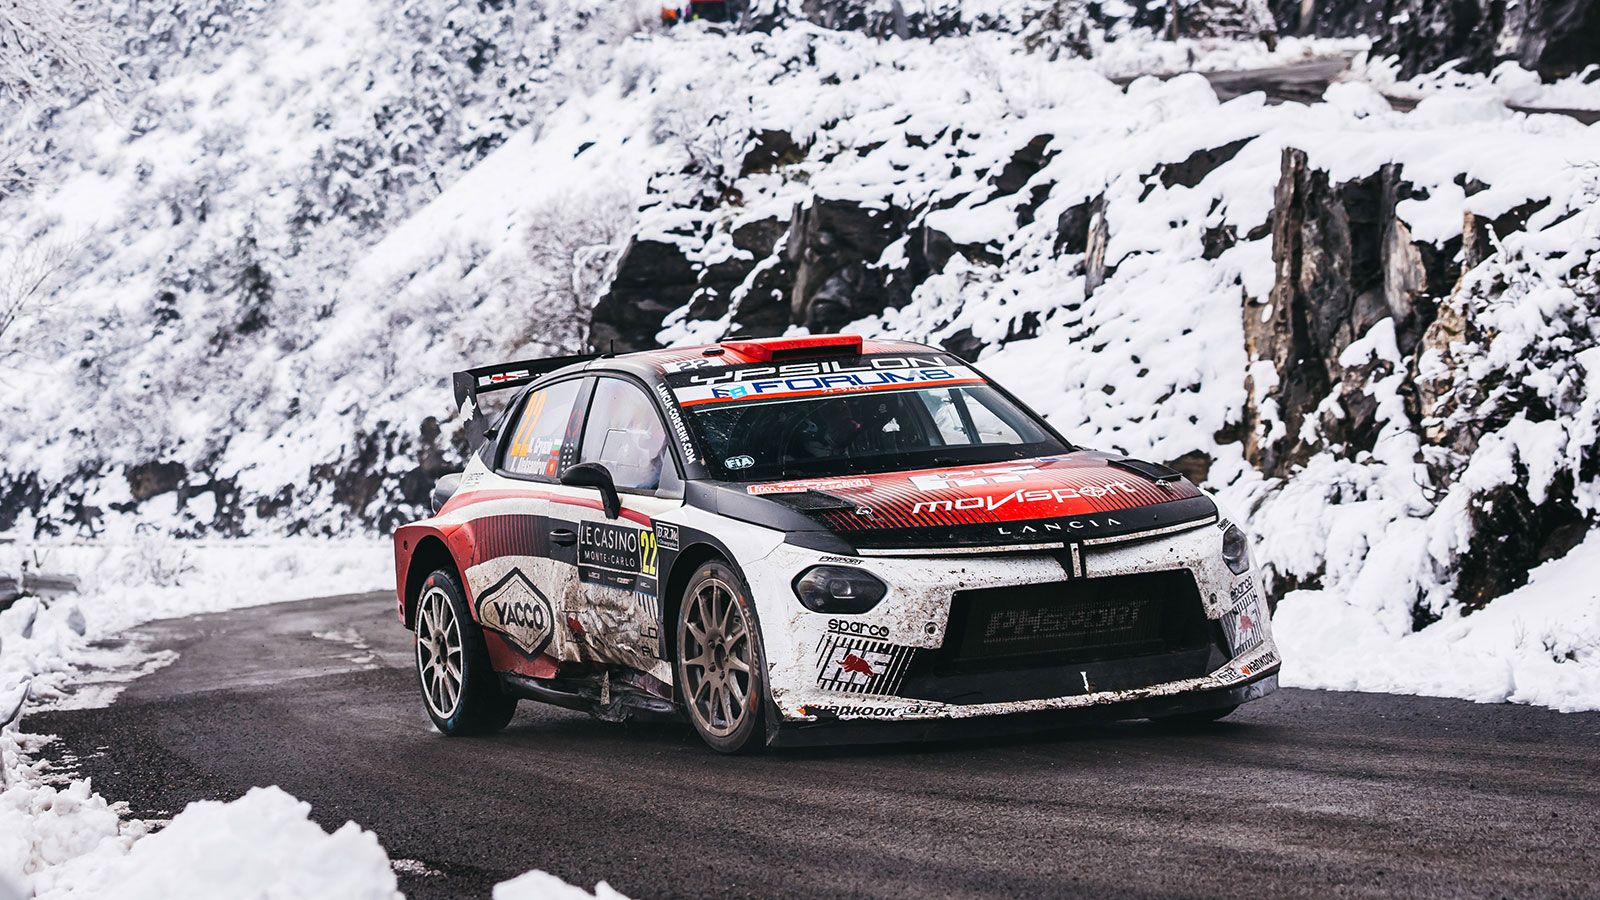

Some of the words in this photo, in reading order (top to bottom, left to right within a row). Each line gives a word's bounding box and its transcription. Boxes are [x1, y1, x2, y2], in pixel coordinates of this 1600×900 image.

[751, 369, 955, 394] FORUM8
[511, 391, 547, 456] 22
[998, 518, 1122, 535] LANCIA
[584, 550, 636, 568] MONTE-CARLO
[640, 530, 658, 575] 22
[493, 601, 546, 631] YACCO
[827, 618, 890, 637] sparco
